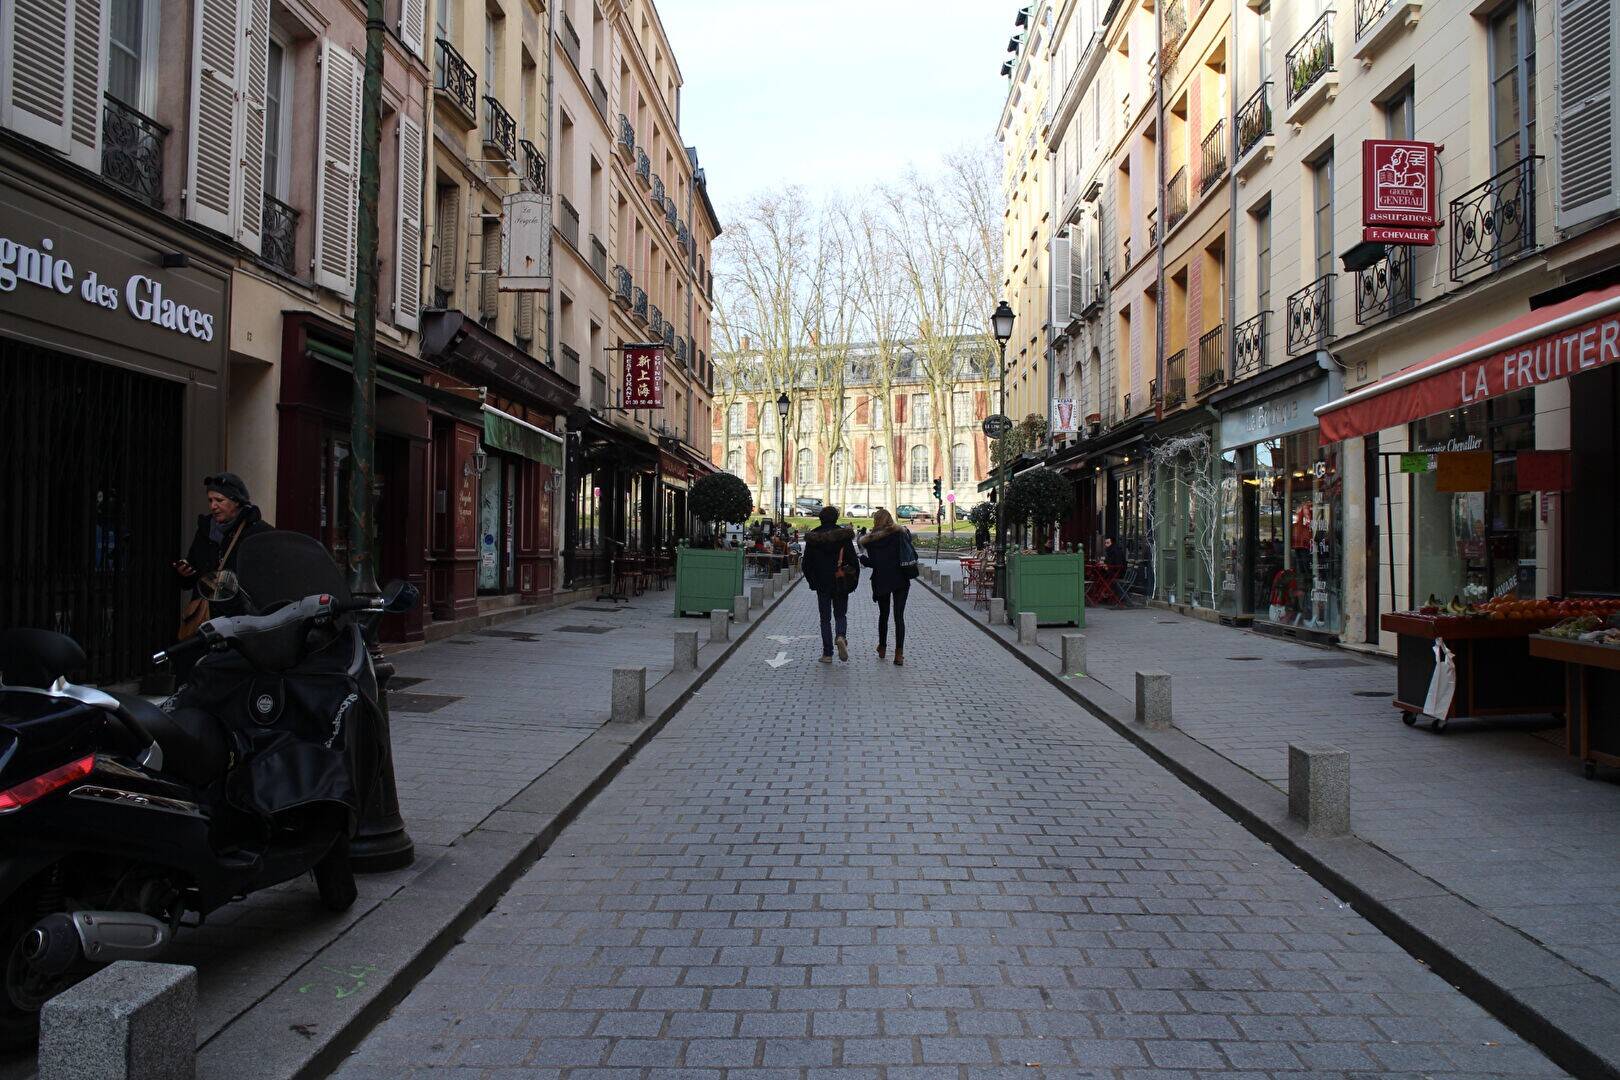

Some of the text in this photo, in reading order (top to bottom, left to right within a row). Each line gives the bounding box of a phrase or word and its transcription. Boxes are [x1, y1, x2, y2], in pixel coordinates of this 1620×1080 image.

[1379, 195, 1423, 206] GENERALI
[1389, 188, 1414, 196] GROUPE
[1369, 213, 1432, 223] assurances
[1372, 231, 1429, 240] F. CHEVALLIER
[81, 270, 119, 310] des
[125, 274, 214, 342] Glaces
[625, 354, 633, 400] RESTAURANT
[636, 354, 652, 398] 新上海
[654, 355, 662, 392] CHINOIS
[1461, 320, 1620, 402] LA FRUITER
